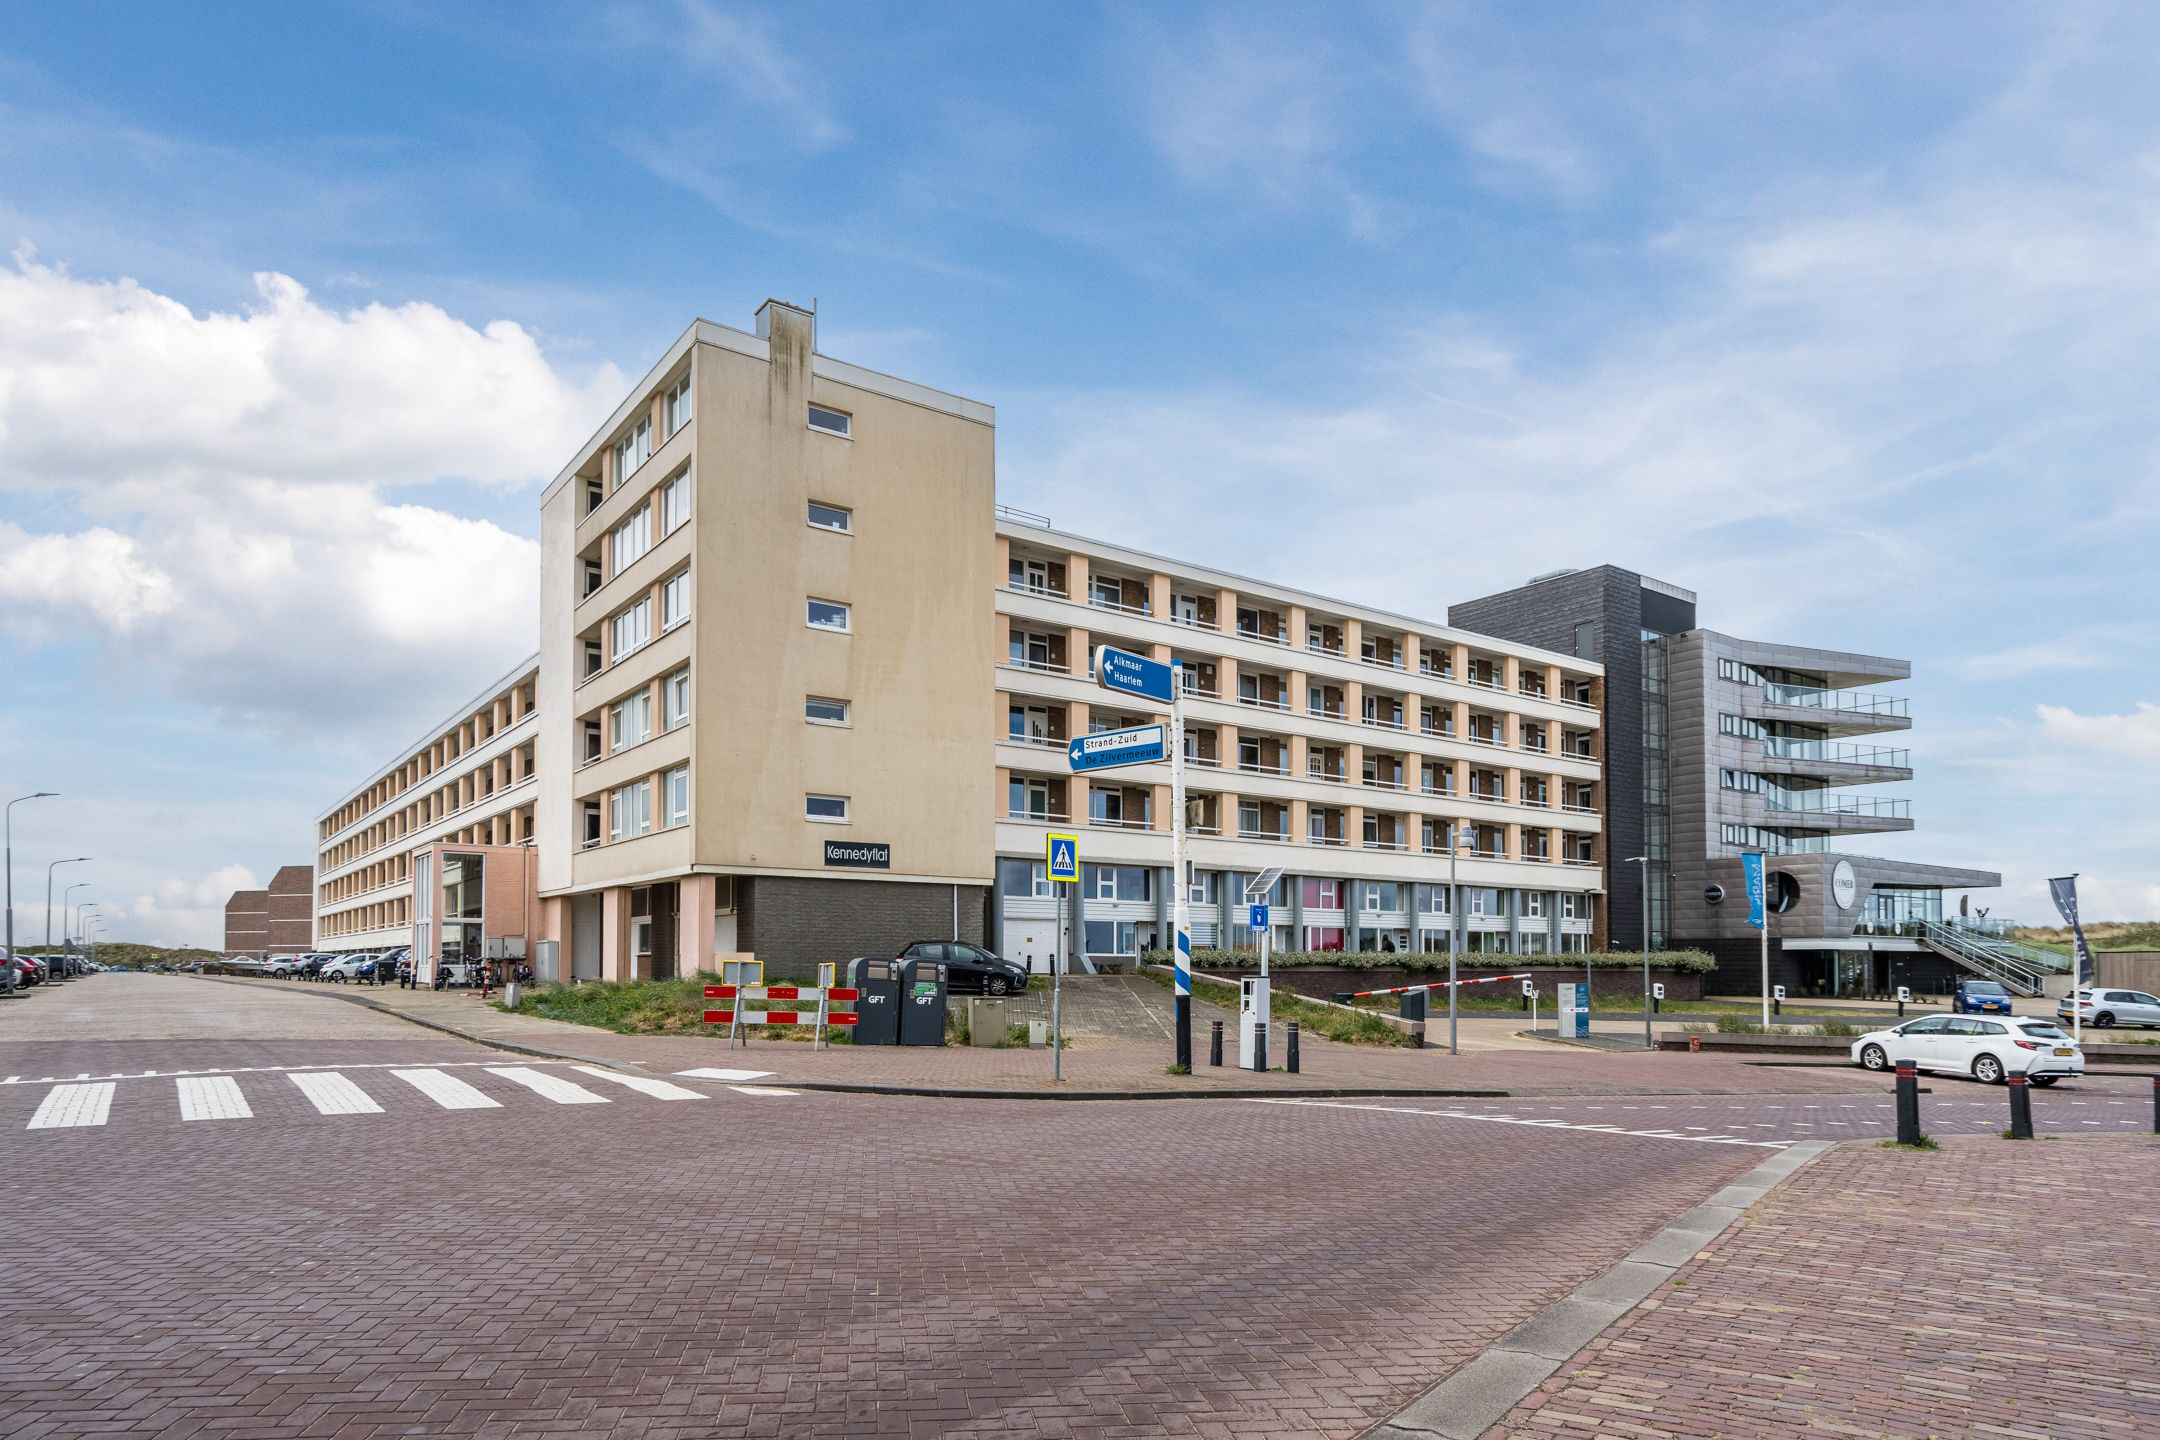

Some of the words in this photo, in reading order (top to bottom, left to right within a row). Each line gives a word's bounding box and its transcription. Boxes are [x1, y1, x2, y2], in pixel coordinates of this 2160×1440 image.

[1113, 655, 1142, 671] Alkmaar
[1114, 671, 1143, 687] Haarlem
[1085, 734, 1138, 749] Strand-Zuid
[1085, 756, 1097, 765] De
[1100, 748, 1160, 763] Zilvermeeuw
[827, 845, 888, 863] Kennedyflat
[868, 995, 885, 1004] GFT
[916, 997, 933, 1005] GFT
